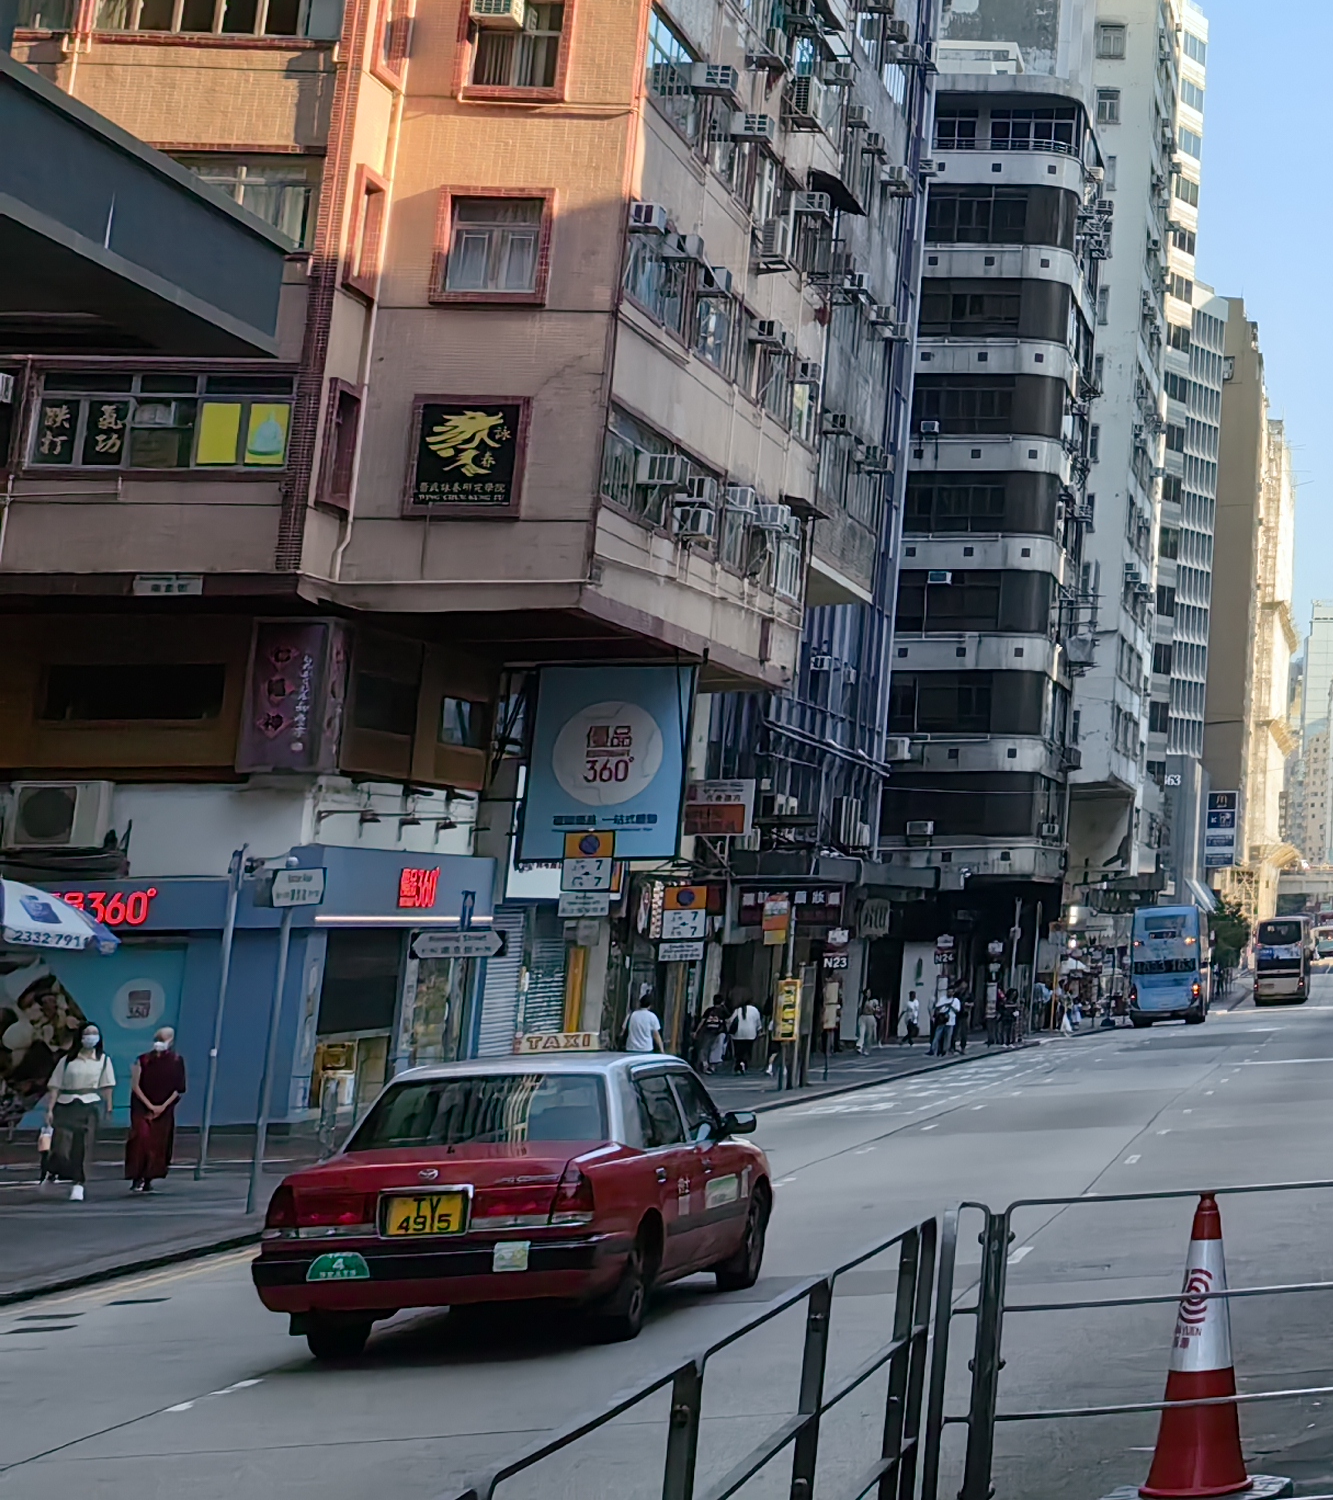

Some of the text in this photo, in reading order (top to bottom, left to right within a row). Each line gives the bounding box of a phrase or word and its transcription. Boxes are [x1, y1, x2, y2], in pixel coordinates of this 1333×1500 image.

[40, 405, 71, 455] 跌打
[824, 956, 847, 968] N23
[526, 1033, 592, 1050] TAXI
[332, 1258, 345, 1270] 4
